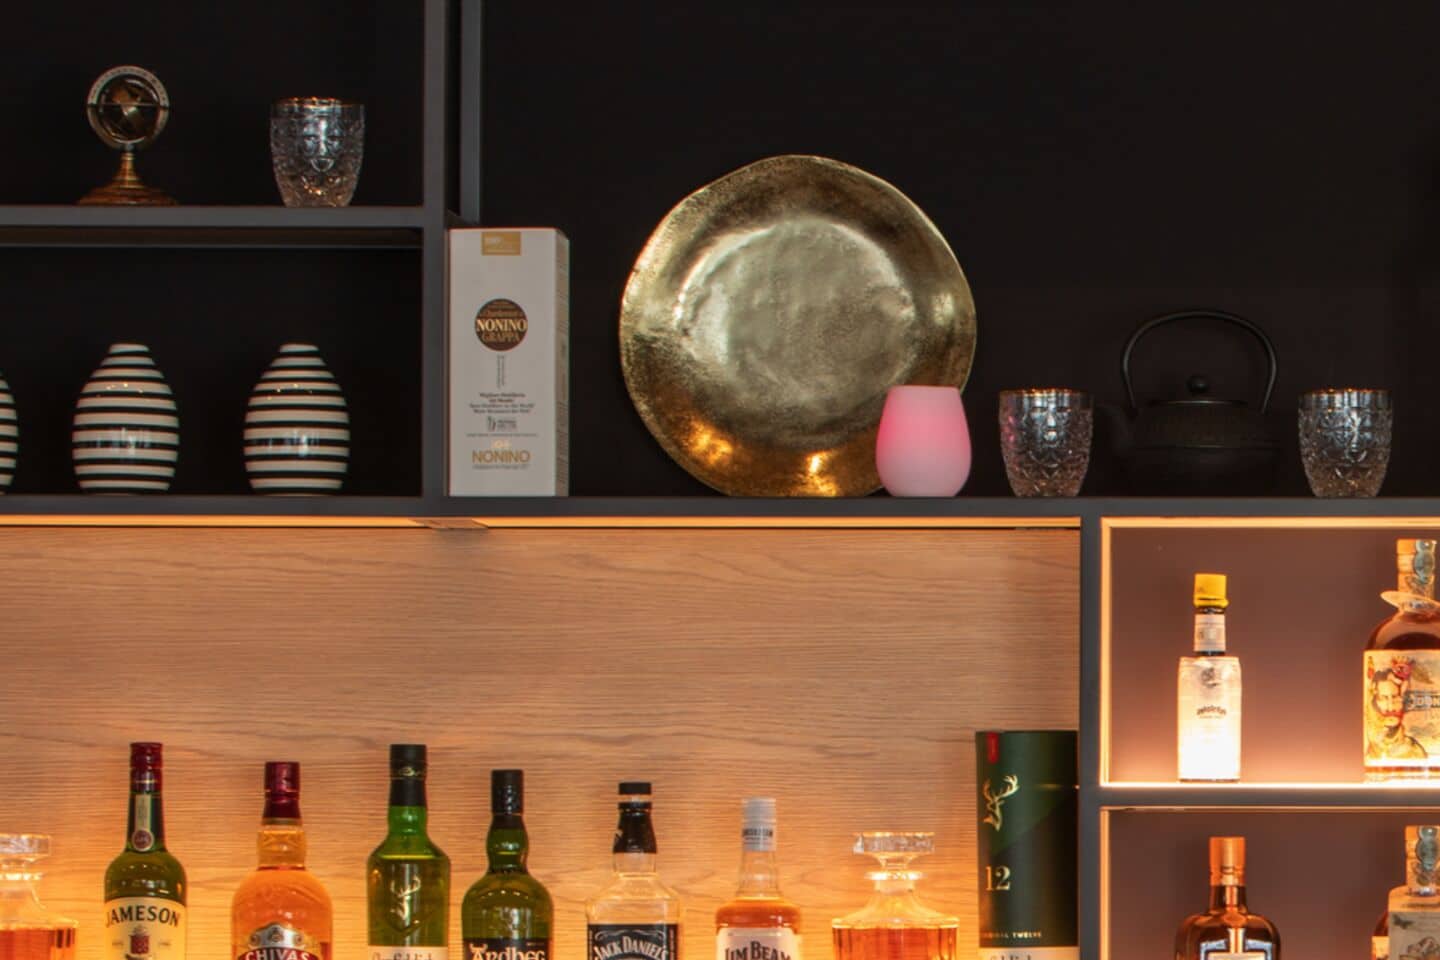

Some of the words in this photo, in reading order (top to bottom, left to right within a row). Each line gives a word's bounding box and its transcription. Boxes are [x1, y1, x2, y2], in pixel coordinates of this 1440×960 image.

[476, 318, 528, 333] NONINO
[471, 449, 531, 464] NONINO
[985, 865, 1011, 891] 12
[105, 904, 181, 928] JAMESON
[1012, 931, 1043, 939] TWELVE
